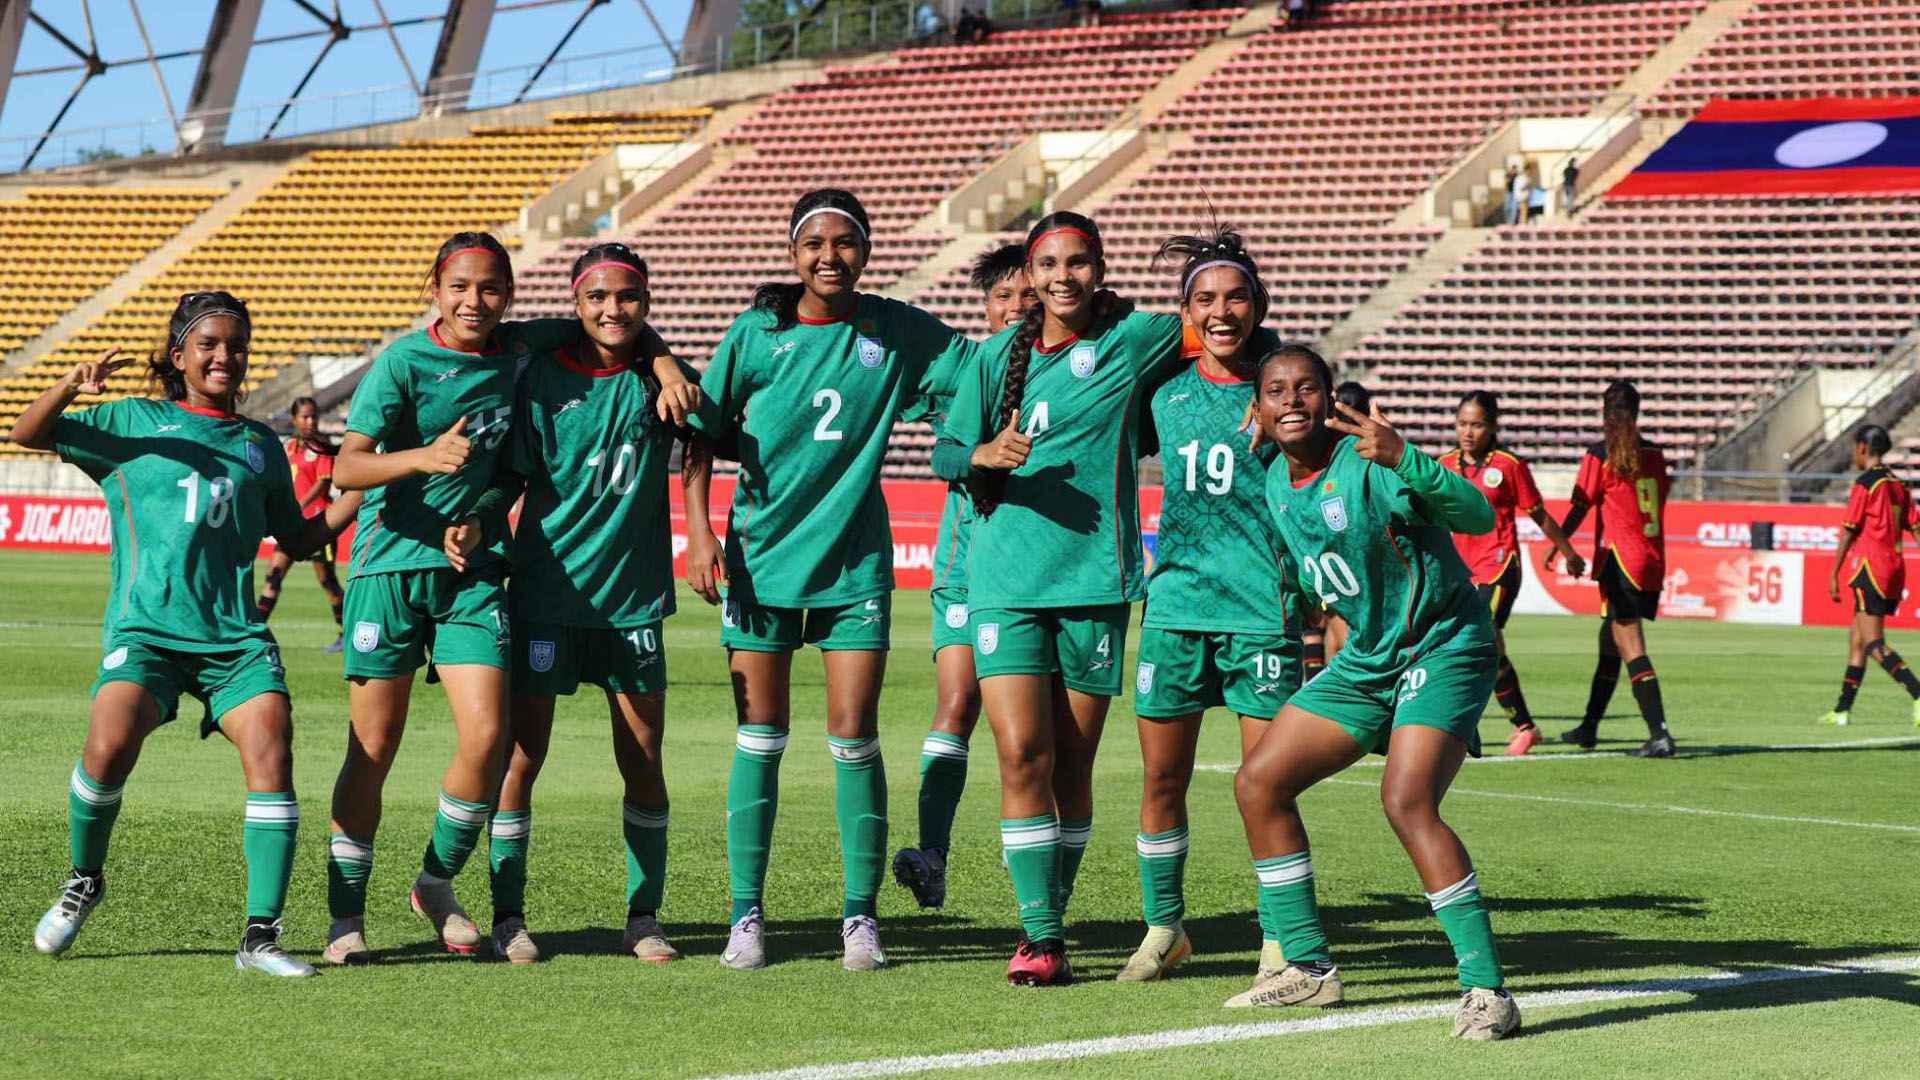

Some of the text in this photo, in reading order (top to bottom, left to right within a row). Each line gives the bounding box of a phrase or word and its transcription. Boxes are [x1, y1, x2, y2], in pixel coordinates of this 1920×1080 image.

[466, 406, 511, 450] 15
[813, 388, 843, 441] 2
[1025, 401, 1049, 438] 4
[588, 444, 637, 497] 10
[1178, 439, 1234, 495] 19
[177, 471, 234, 528] 18
[1636, 478, 1659, 537] 9
[1697, 522, 1840, 550] QUAFIERS
[1304, 552, 1360, 603] 20
[1748, 565, 1782, 604] 56
[627, 628, 656, 655] 10
[1096, 633, 1110, 657] 4
[1252, 653, 1281, 680] 19
[1250, 981, 1309, 1006] GENESIS
